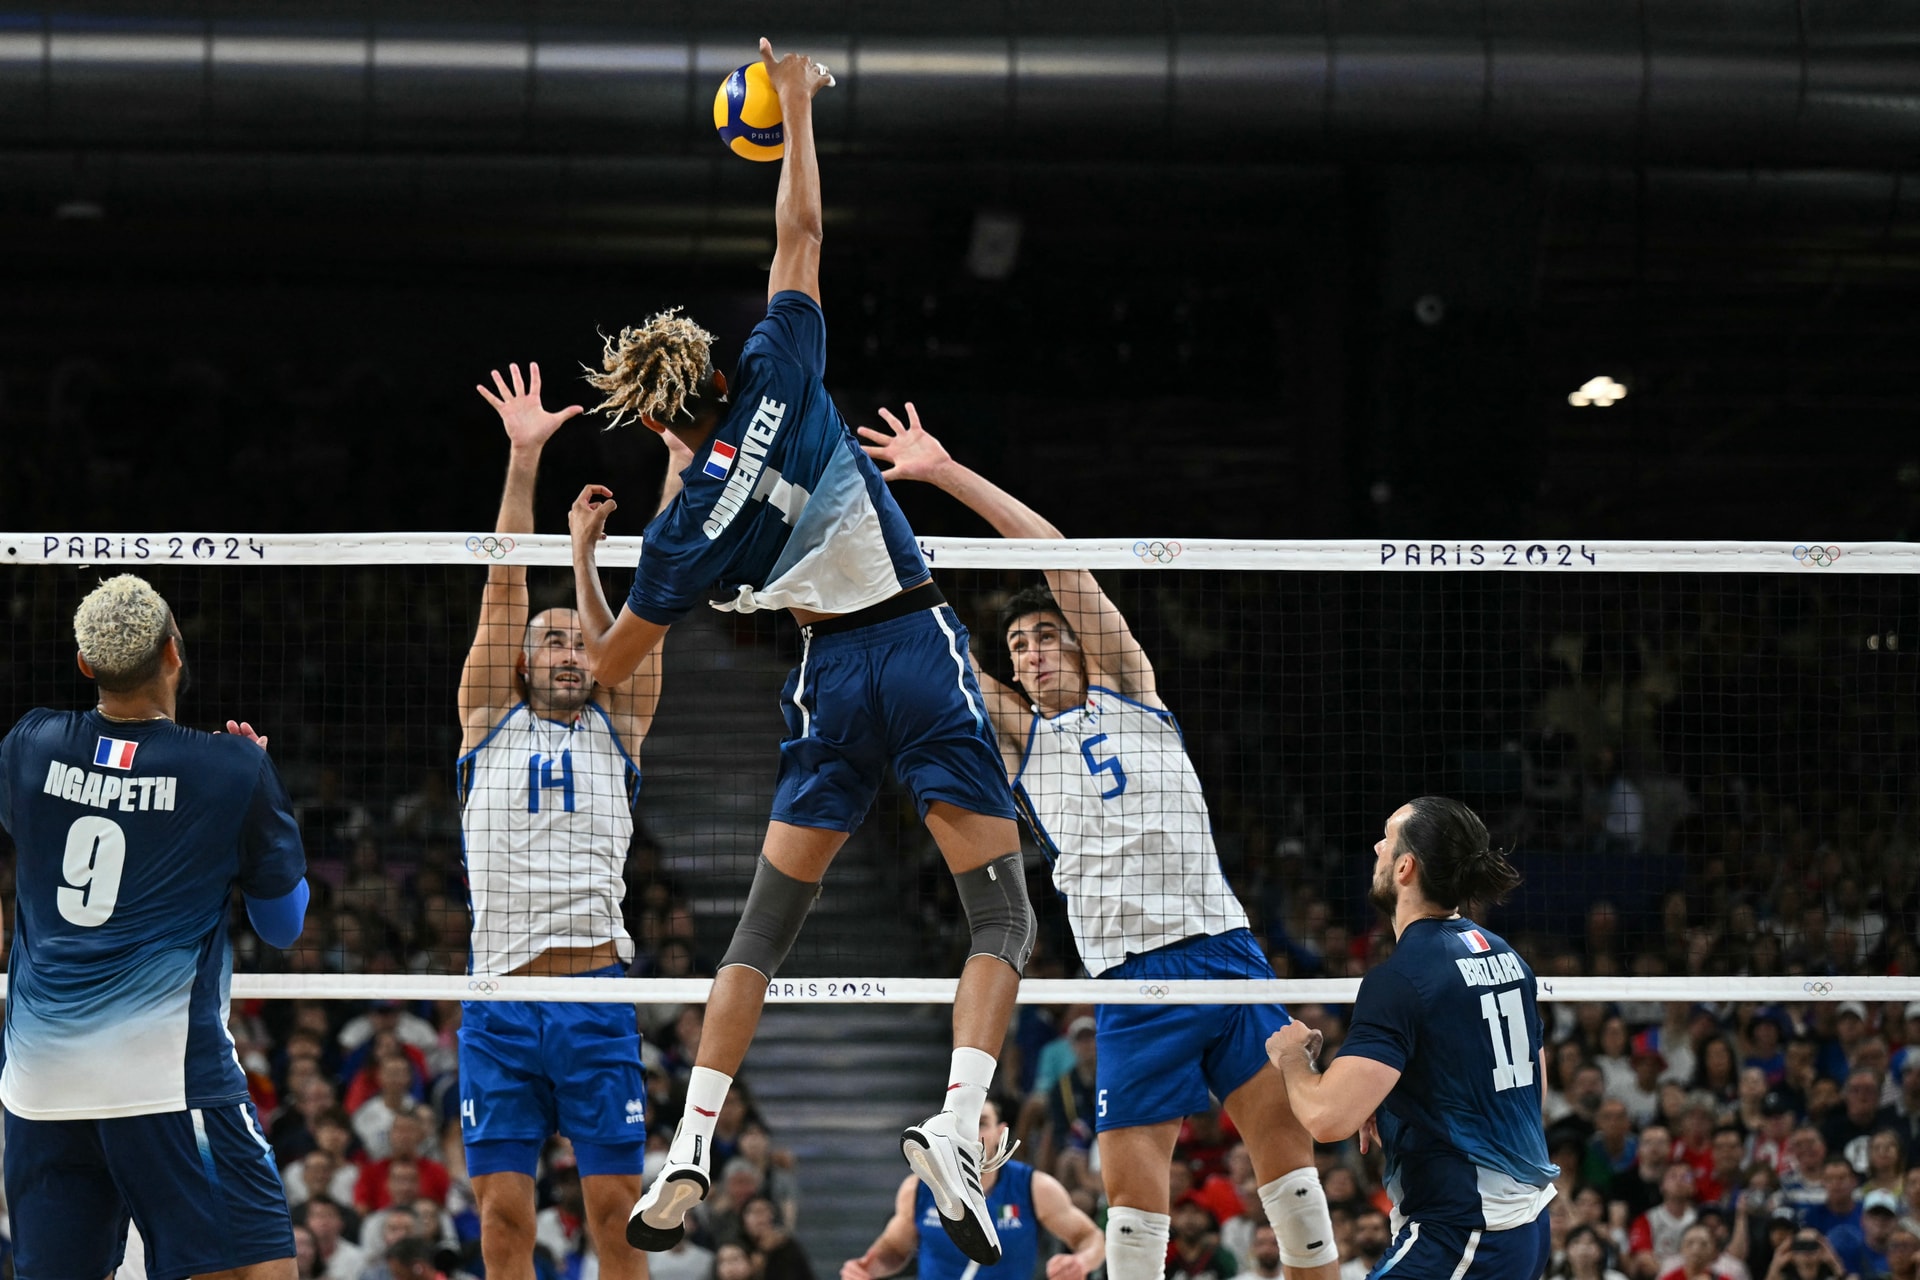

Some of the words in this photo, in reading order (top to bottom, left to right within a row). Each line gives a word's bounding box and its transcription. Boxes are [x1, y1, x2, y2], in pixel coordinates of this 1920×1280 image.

[751, 132, 780, 140] PARIS
[702, 395, 787, 541] CHINENYEZE
[751, 465, 812, 528] 1
[168, 537, 264, 559] 2024
[1502, 544, 1596, 566] 2024
[43, 759, 178, 813] NGAPETH
[528, 748, 576, 815] 14
[1080, 732, 1128, 800] 5
[56, 815, 127, 928] 9
[768, 983, 818, 997] ARiS
[827, 983, 886, 997] 2024
[1479, 987, 1535, 1093] 11
[1098, 1089, 1108, 1118] 5
